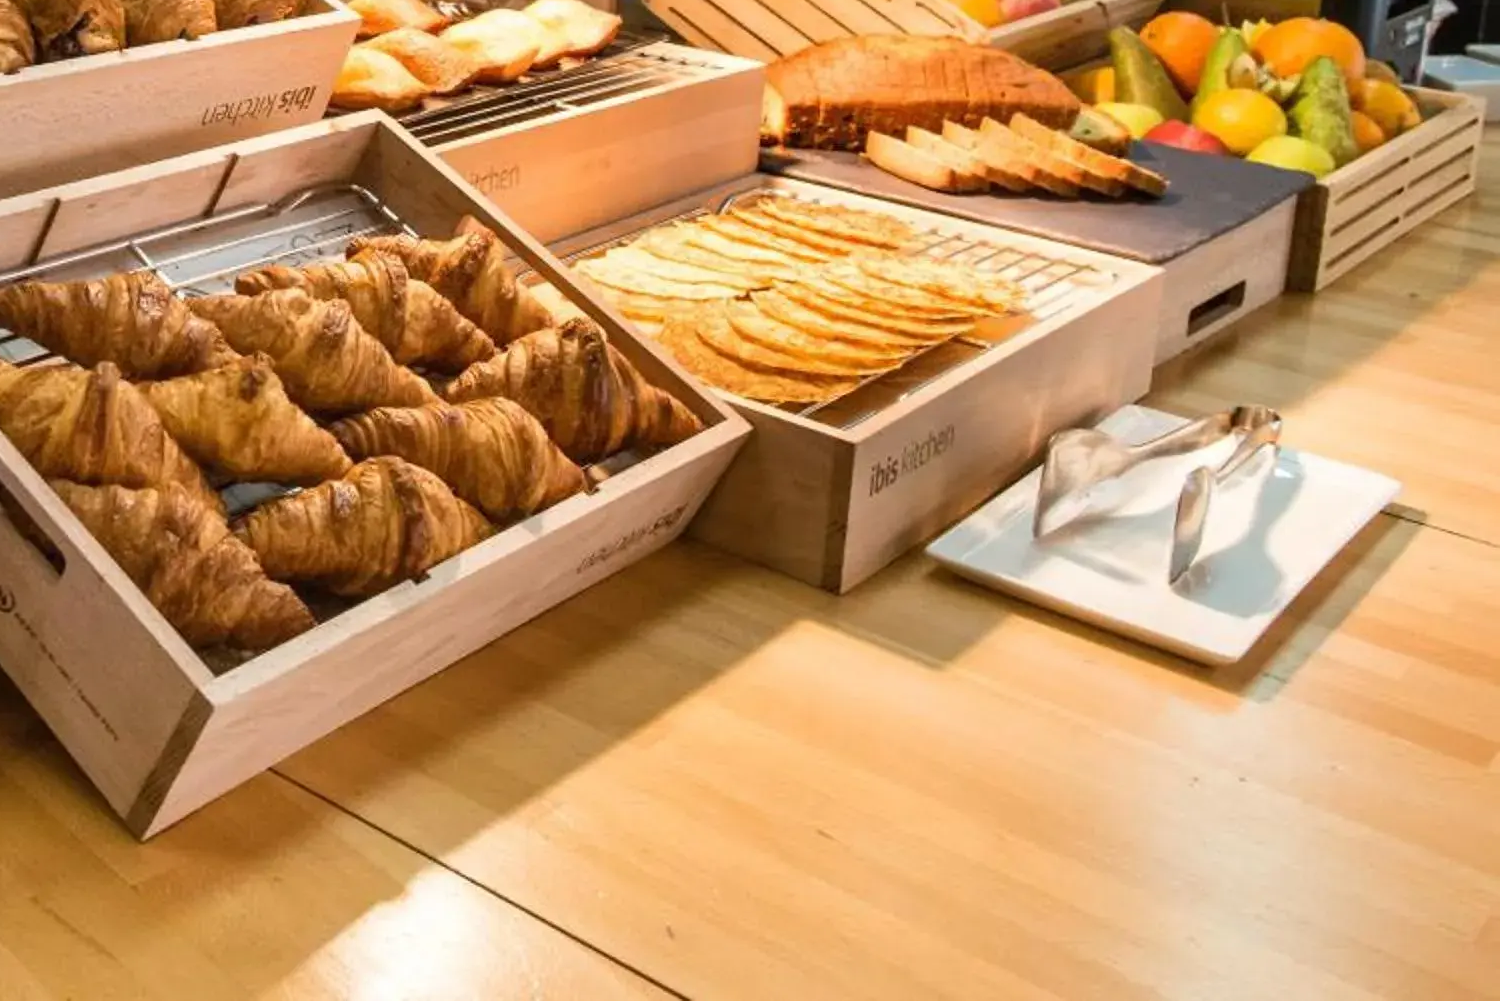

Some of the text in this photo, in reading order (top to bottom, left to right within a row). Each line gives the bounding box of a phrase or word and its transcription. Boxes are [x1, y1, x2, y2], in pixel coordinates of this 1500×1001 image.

[201, 85, 317, 126] ibis kitchen
[869, 423, 955, 497] ibis kitchen
